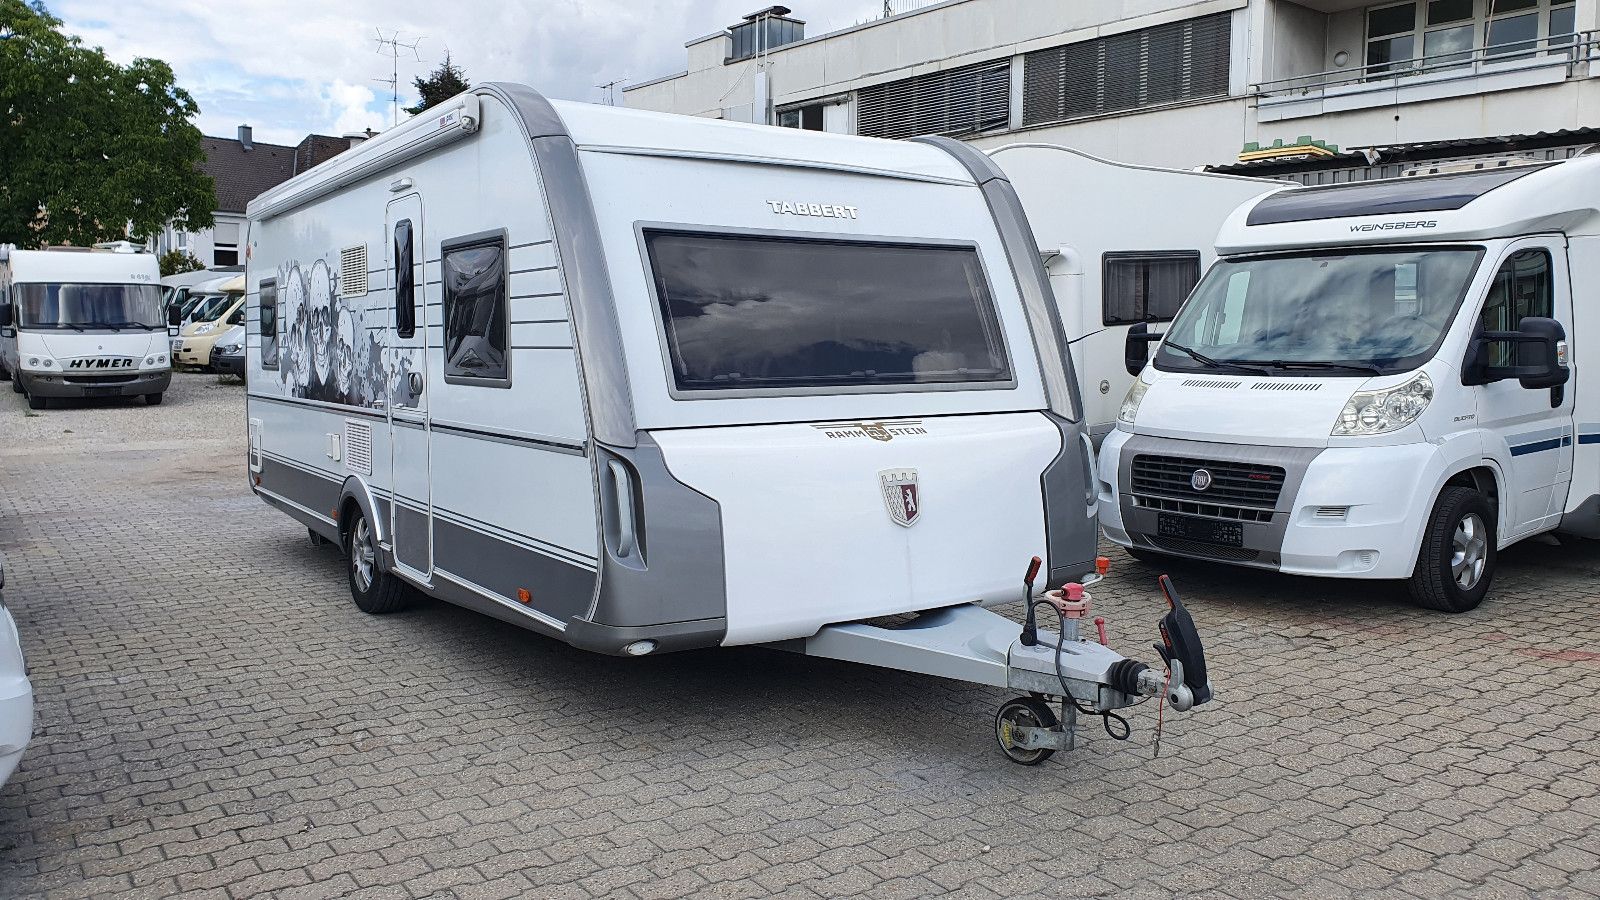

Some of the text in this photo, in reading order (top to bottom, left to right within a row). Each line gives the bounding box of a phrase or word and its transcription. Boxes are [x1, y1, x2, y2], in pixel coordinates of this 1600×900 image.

[765, 199, 858, 219] TABBERT
[1350, 220, 1438, 232] WEINSBERG
[69, 358, 133, 368] HYMER
[825, 427, 928, 439] RAMM STEIN
